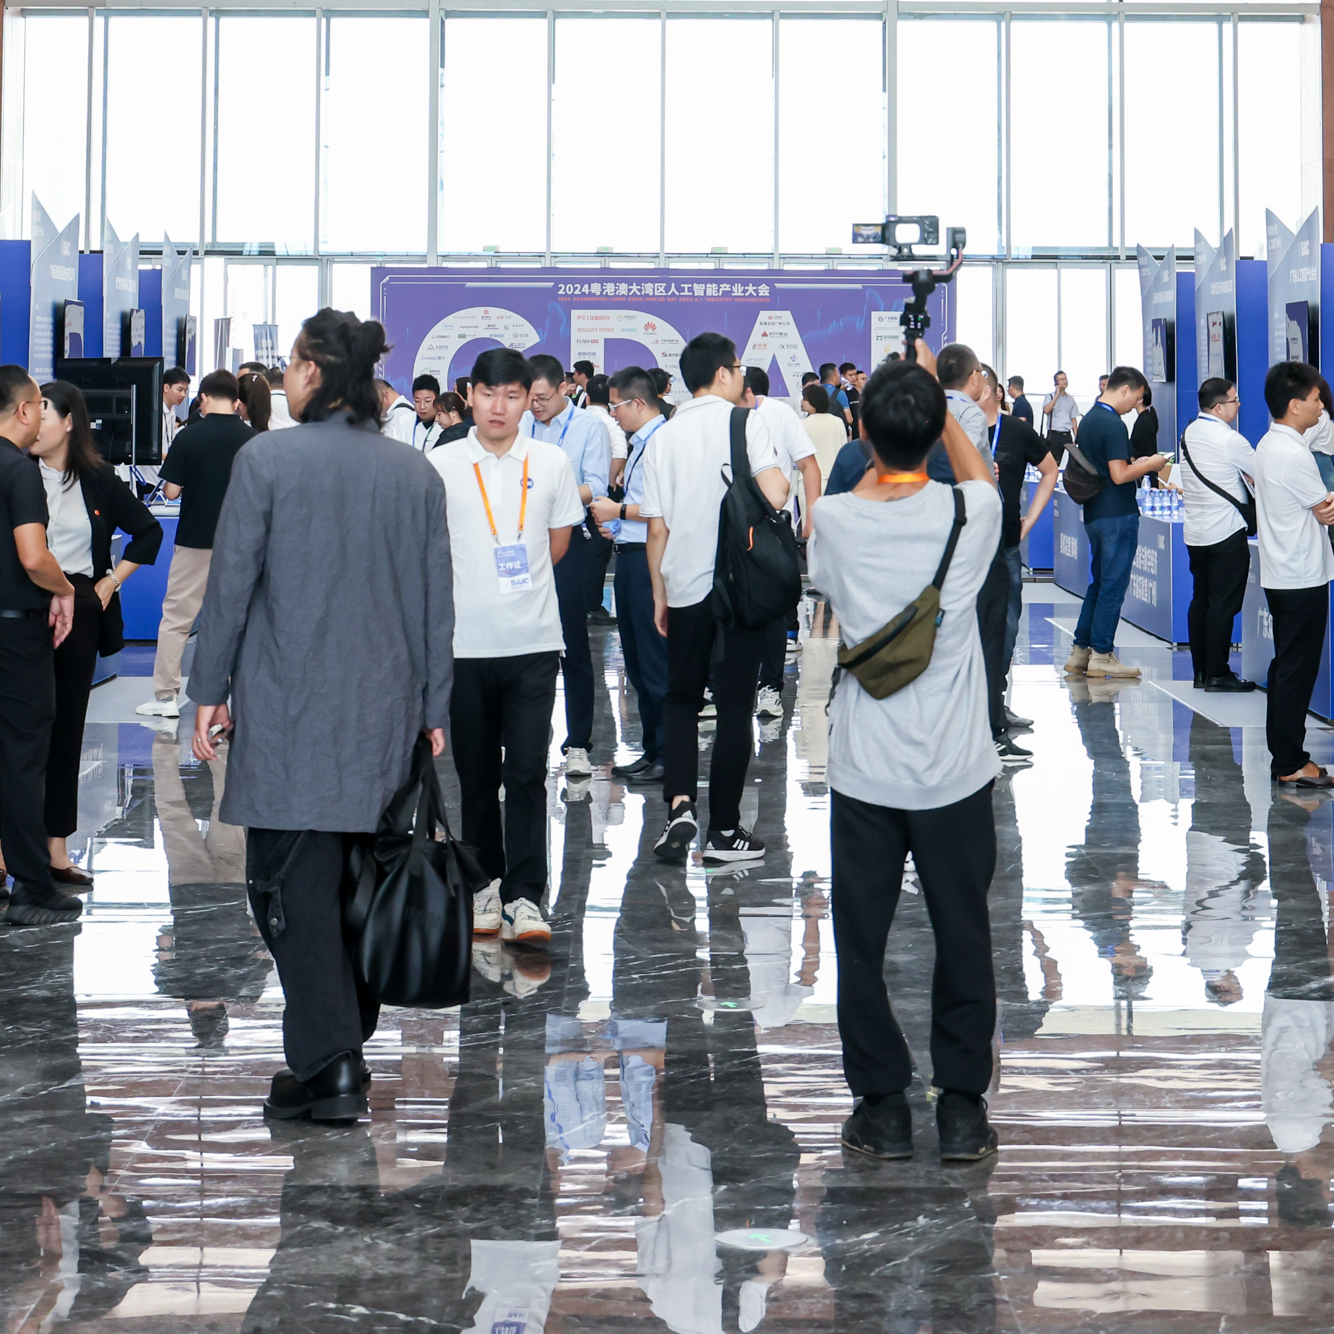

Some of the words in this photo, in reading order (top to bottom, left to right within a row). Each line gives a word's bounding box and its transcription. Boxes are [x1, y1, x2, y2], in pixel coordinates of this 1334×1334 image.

[557, 282, 771, 297] 2024粤港澳大湾区人工智能产业大会
[498, 560, 522, 572] 工作证
[510, 577, 530, 587] BAIC
